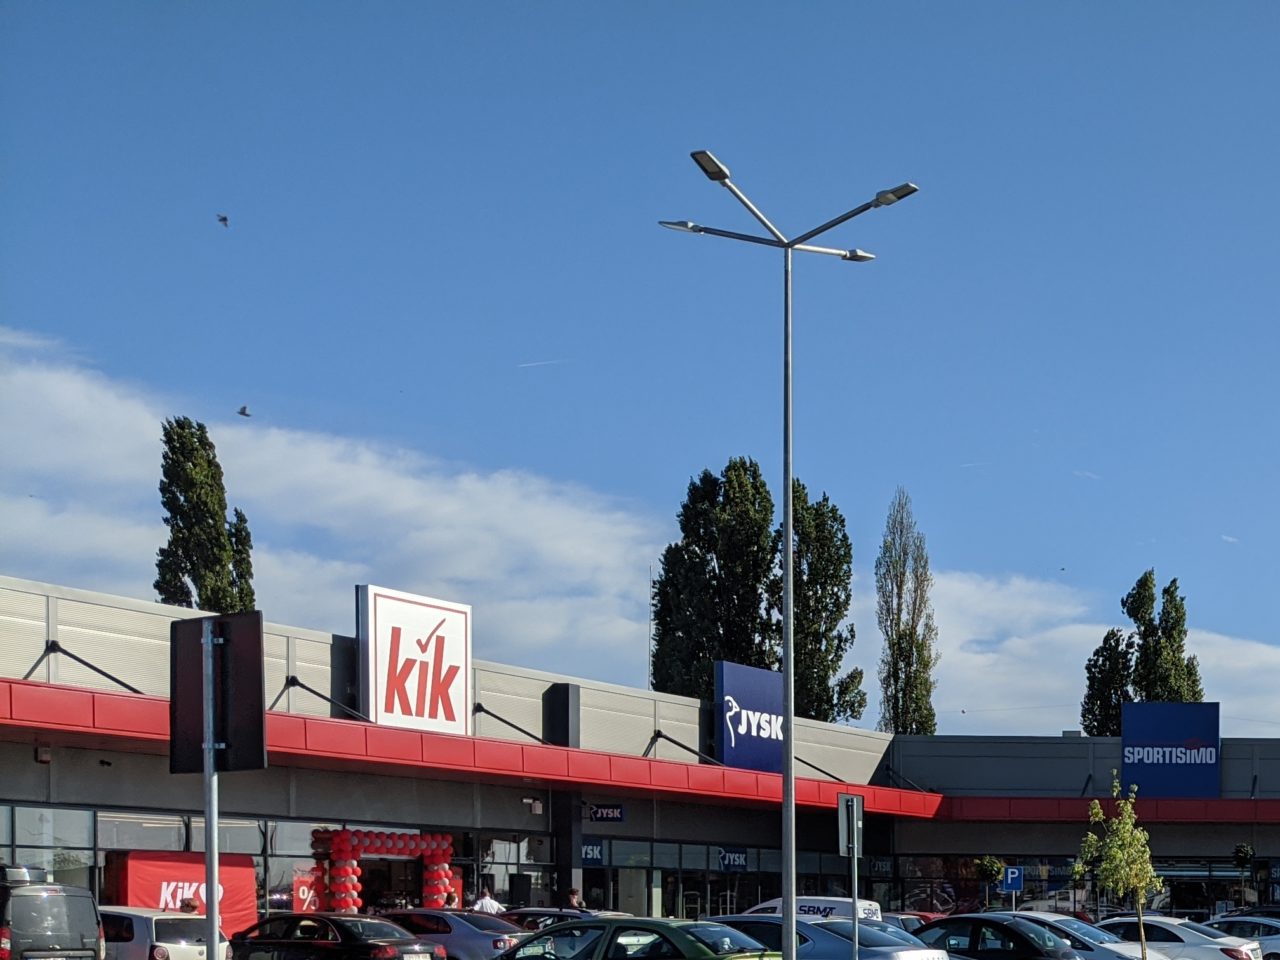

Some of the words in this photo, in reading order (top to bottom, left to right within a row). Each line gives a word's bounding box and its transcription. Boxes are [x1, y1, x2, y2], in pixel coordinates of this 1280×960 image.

[737, 709, 784, 741] JYSK
[596, 807, 621, 819] JYSK
[582, 845, 602, 859] YSK
[725, 852, 747, 866] JYSK
[1007, 868, 1019, 884] P
